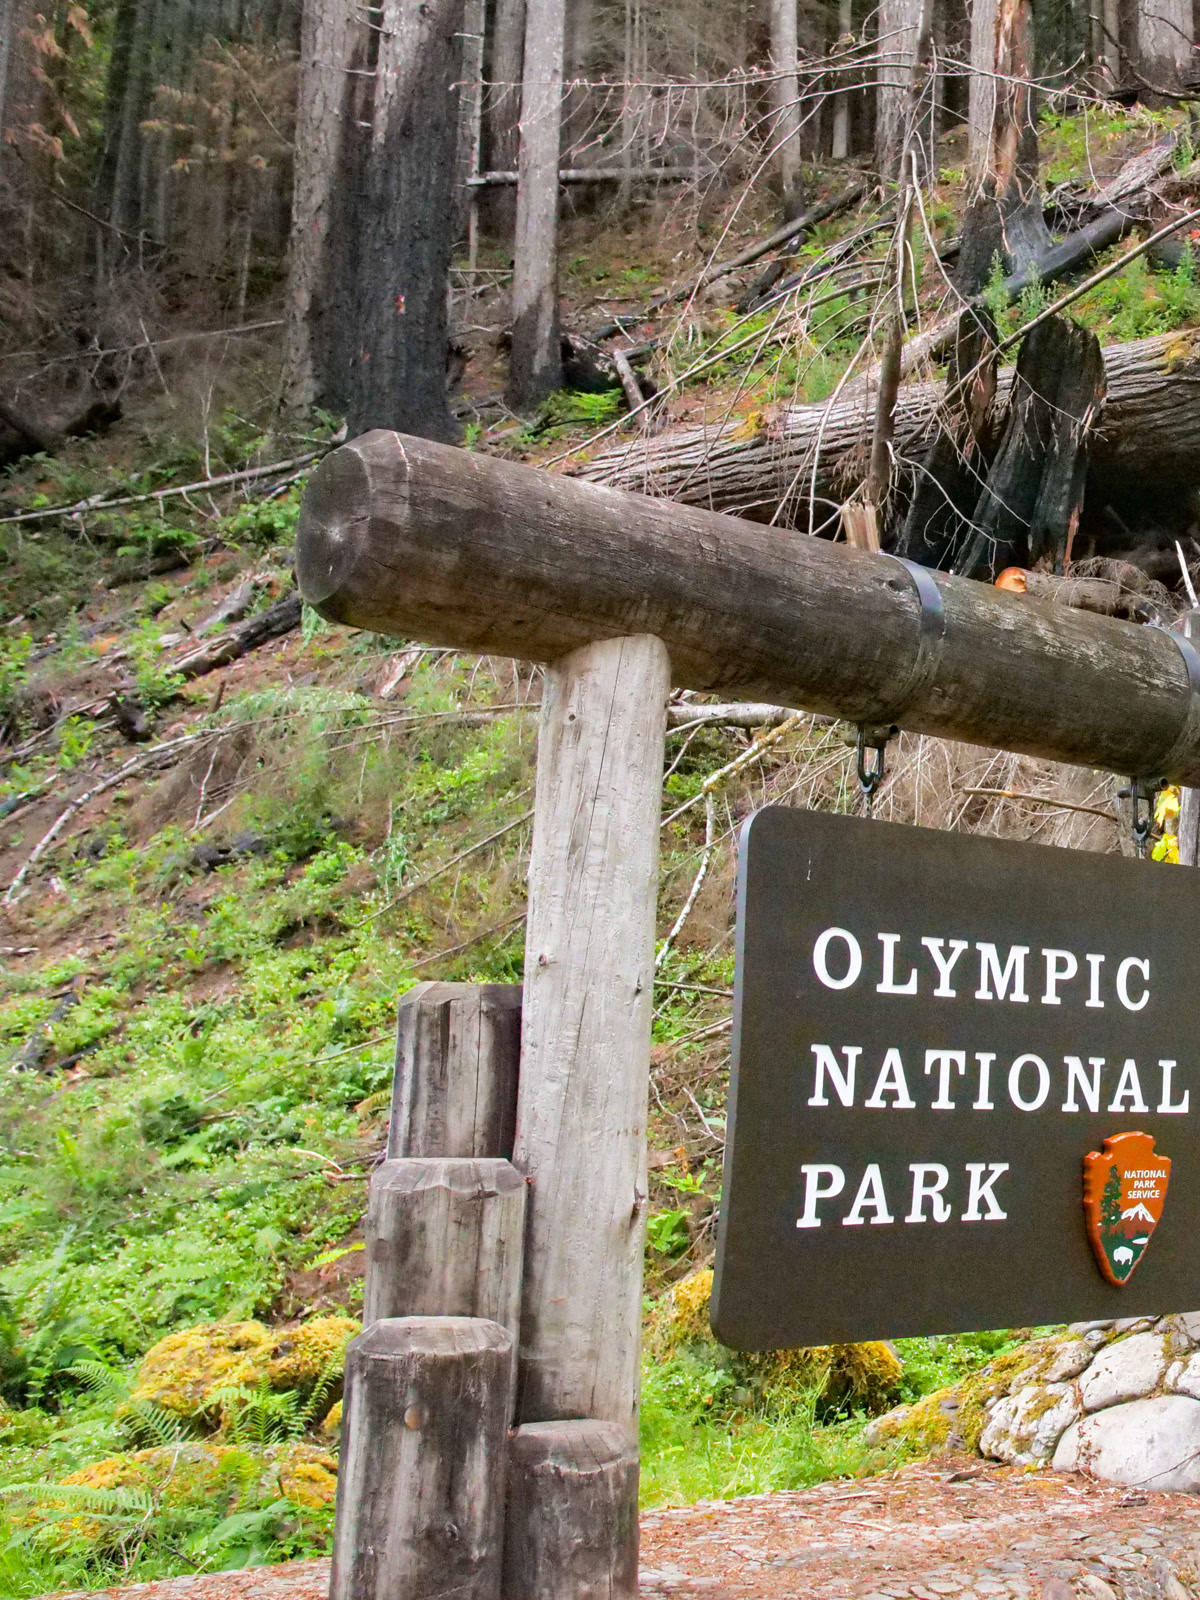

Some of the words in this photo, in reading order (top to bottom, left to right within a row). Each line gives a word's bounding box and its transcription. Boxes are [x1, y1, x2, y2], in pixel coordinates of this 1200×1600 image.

[812, 926, 1150, 1011] OLYMPIC
[807, 1044, 1190, 1114] NATIONAL
[1123, 1169, 1167, 1179] NATIONAL
[1133, 1179, 1156, 1189] PARK
[795, 1162, 1010, 1229] PARK
[1127, 1189, 1160, 1199] SERVICE
